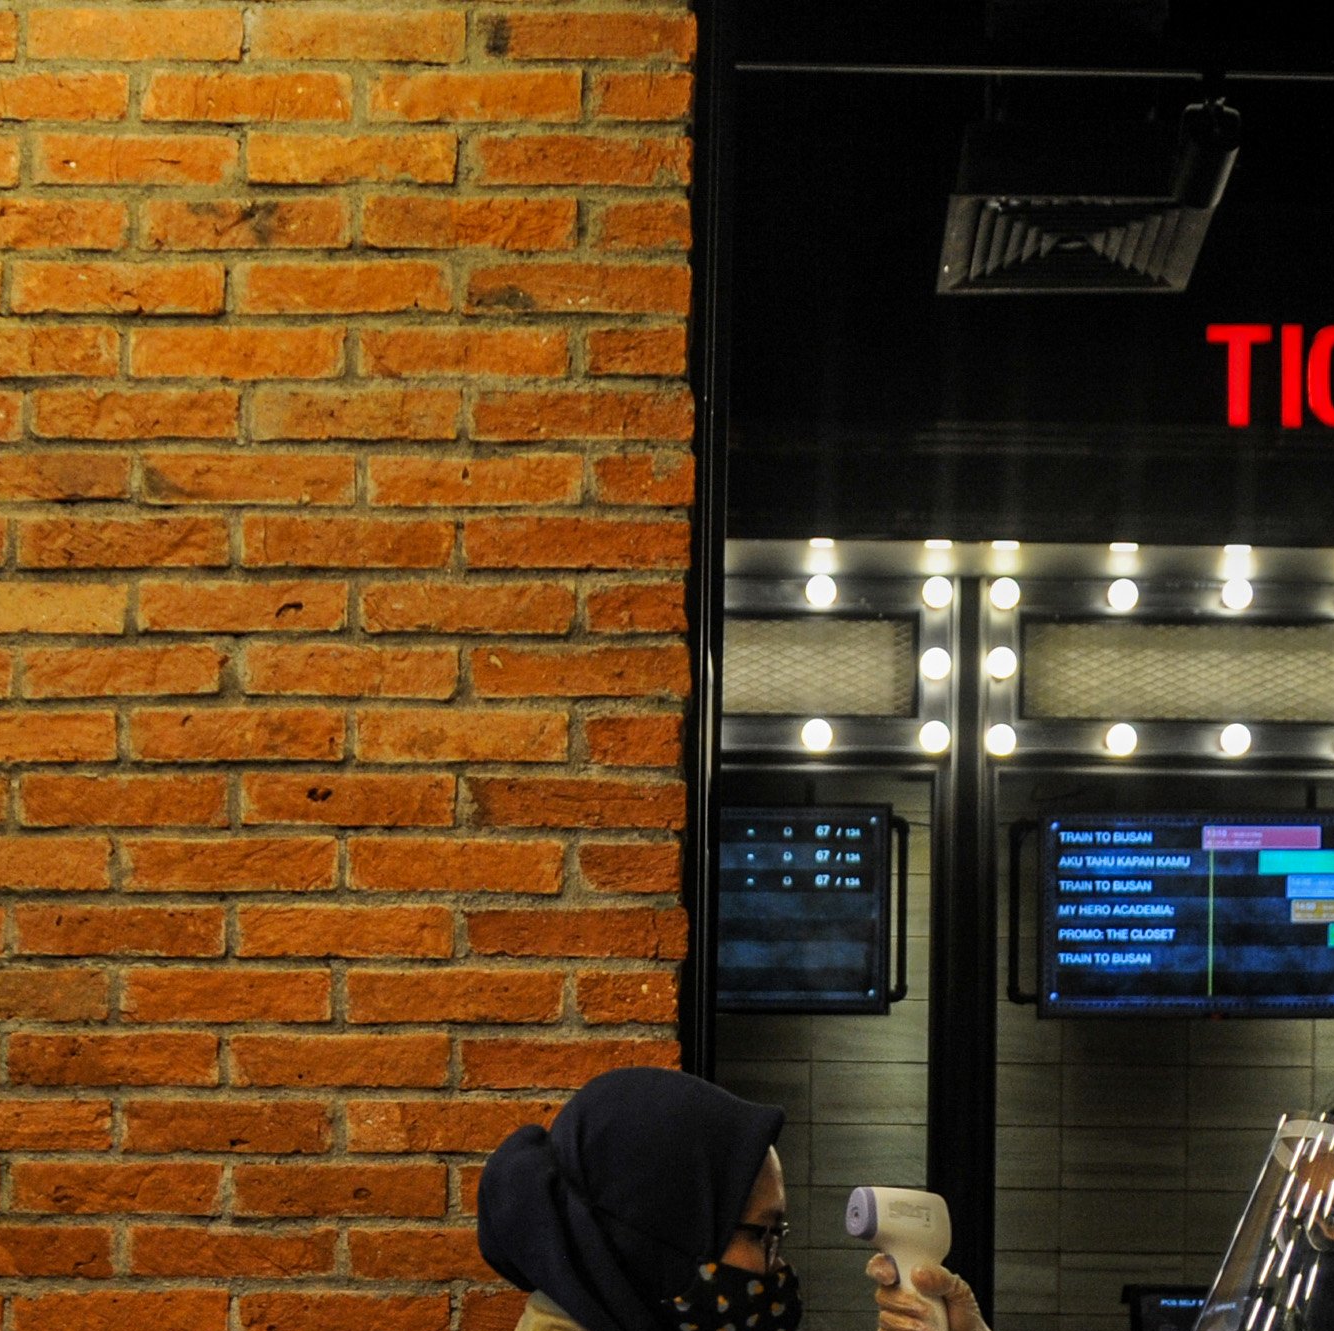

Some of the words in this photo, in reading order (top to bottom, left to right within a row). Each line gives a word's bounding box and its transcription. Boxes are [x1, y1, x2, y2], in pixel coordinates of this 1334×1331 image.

[815, 824, 831, 837] 67
[1059, 832, 1092, 843] TRAIN
[1094, 832, 1110, 843] TO
[1112, 832, 1153, 844] BUSAN
[815, 849, 830, 862] 67
[1058, 856, 1083, 868] AKU
[1084, 856, 1115, 868] TAHU
[1116, 856, 1155, 868] KAPAN
[1156, 856, 1191, 868] KAMU
[815, 874, 830, 886] 67
[1059, 880, 1092, 892] TRAIN
[1094, 880, 1110, 892] TO
[1112, 880, 1153, 892] BUSAN
[1058, 904, 1077, 916] MY
[1078, 904, 1111, 916] HERO
[1112, 904, 1175, 916] ACADEMIA:
[1058, 928, 1105, 940] PROMO:
[1106, 928, 1128, 940] THE
[1129, 928, 1175, 940] CLOSET
[1058, 952, 1092, 964] TRAIN
[1094, 952, 1110, 964] TO
[1112, 952, 1152, 964] BUSAN
